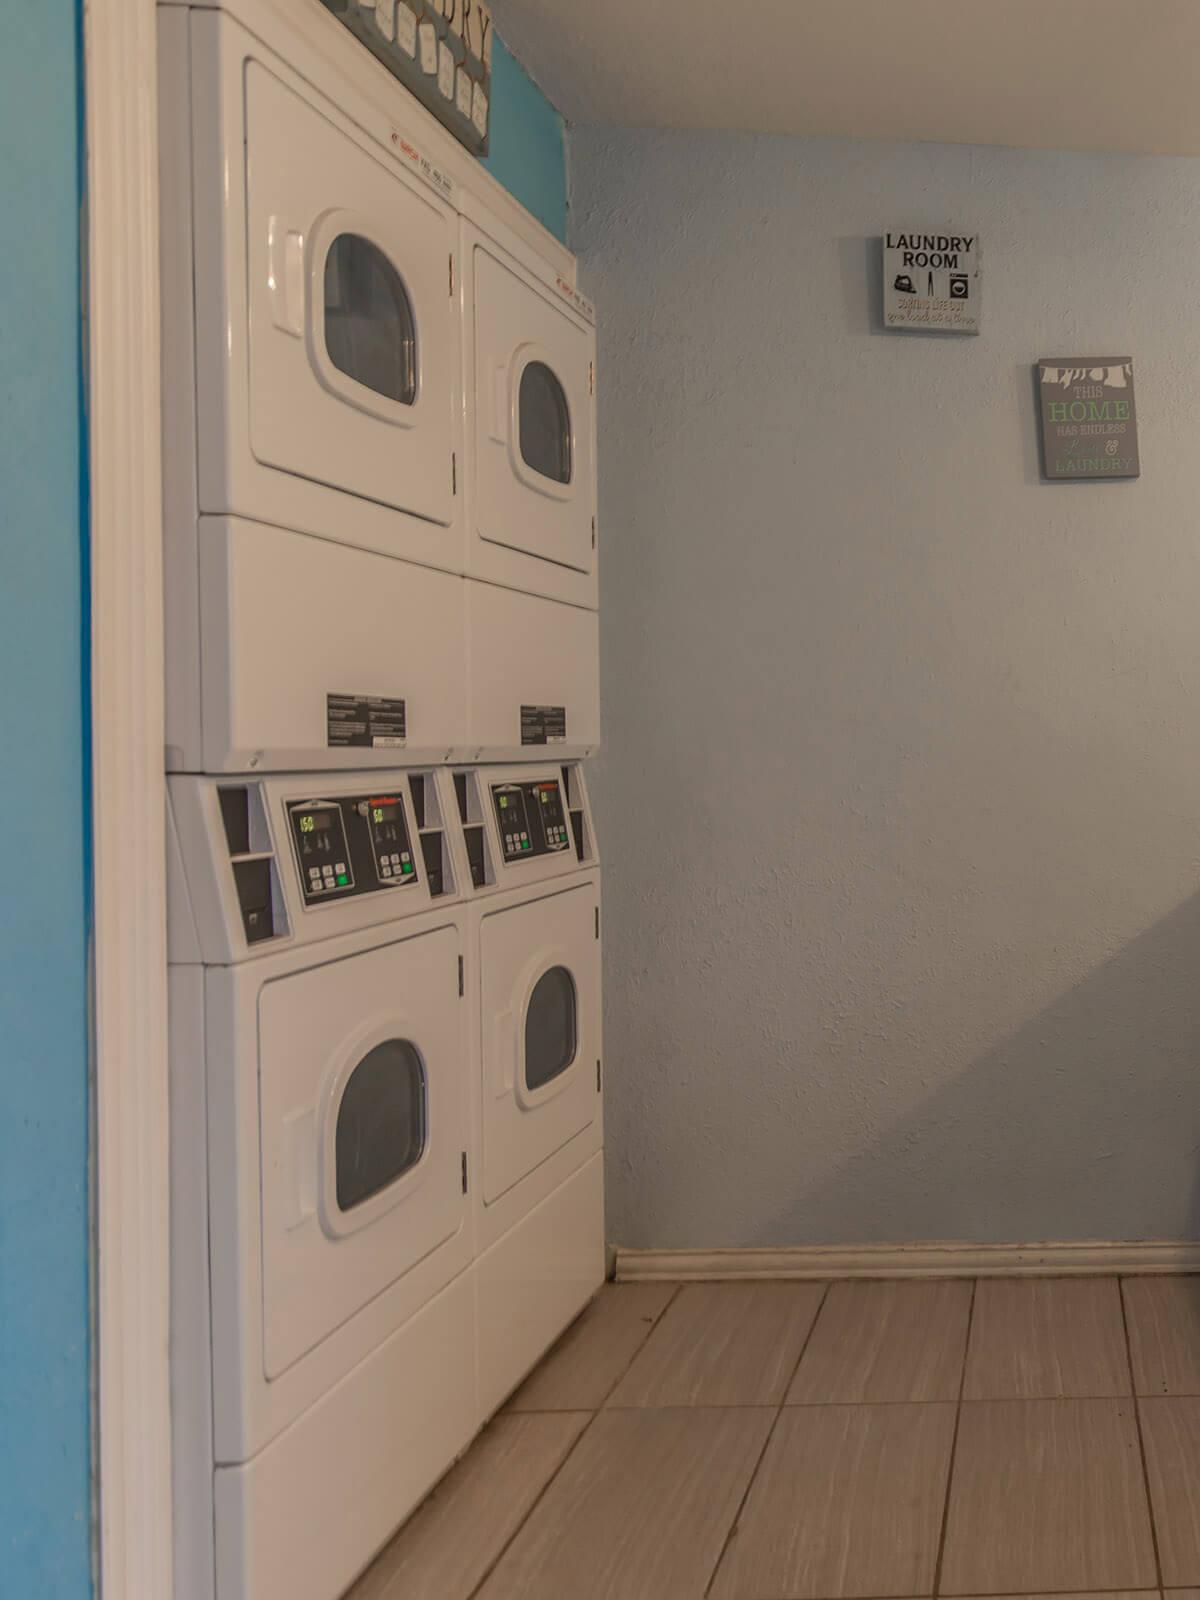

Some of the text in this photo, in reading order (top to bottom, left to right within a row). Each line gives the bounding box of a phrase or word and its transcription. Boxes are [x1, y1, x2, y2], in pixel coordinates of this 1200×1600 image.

[886, 233, 974, 252] LAUNDRY
[903, 252, 958, 269] ROOM
[1073, 385, 1103, 399] THIS
[1048, 400, 1130, 422] HOME
[1057, 423, 1127, 437] HAS ENDLESS
[1055, 457, 1132, 472] LAUNDRY
